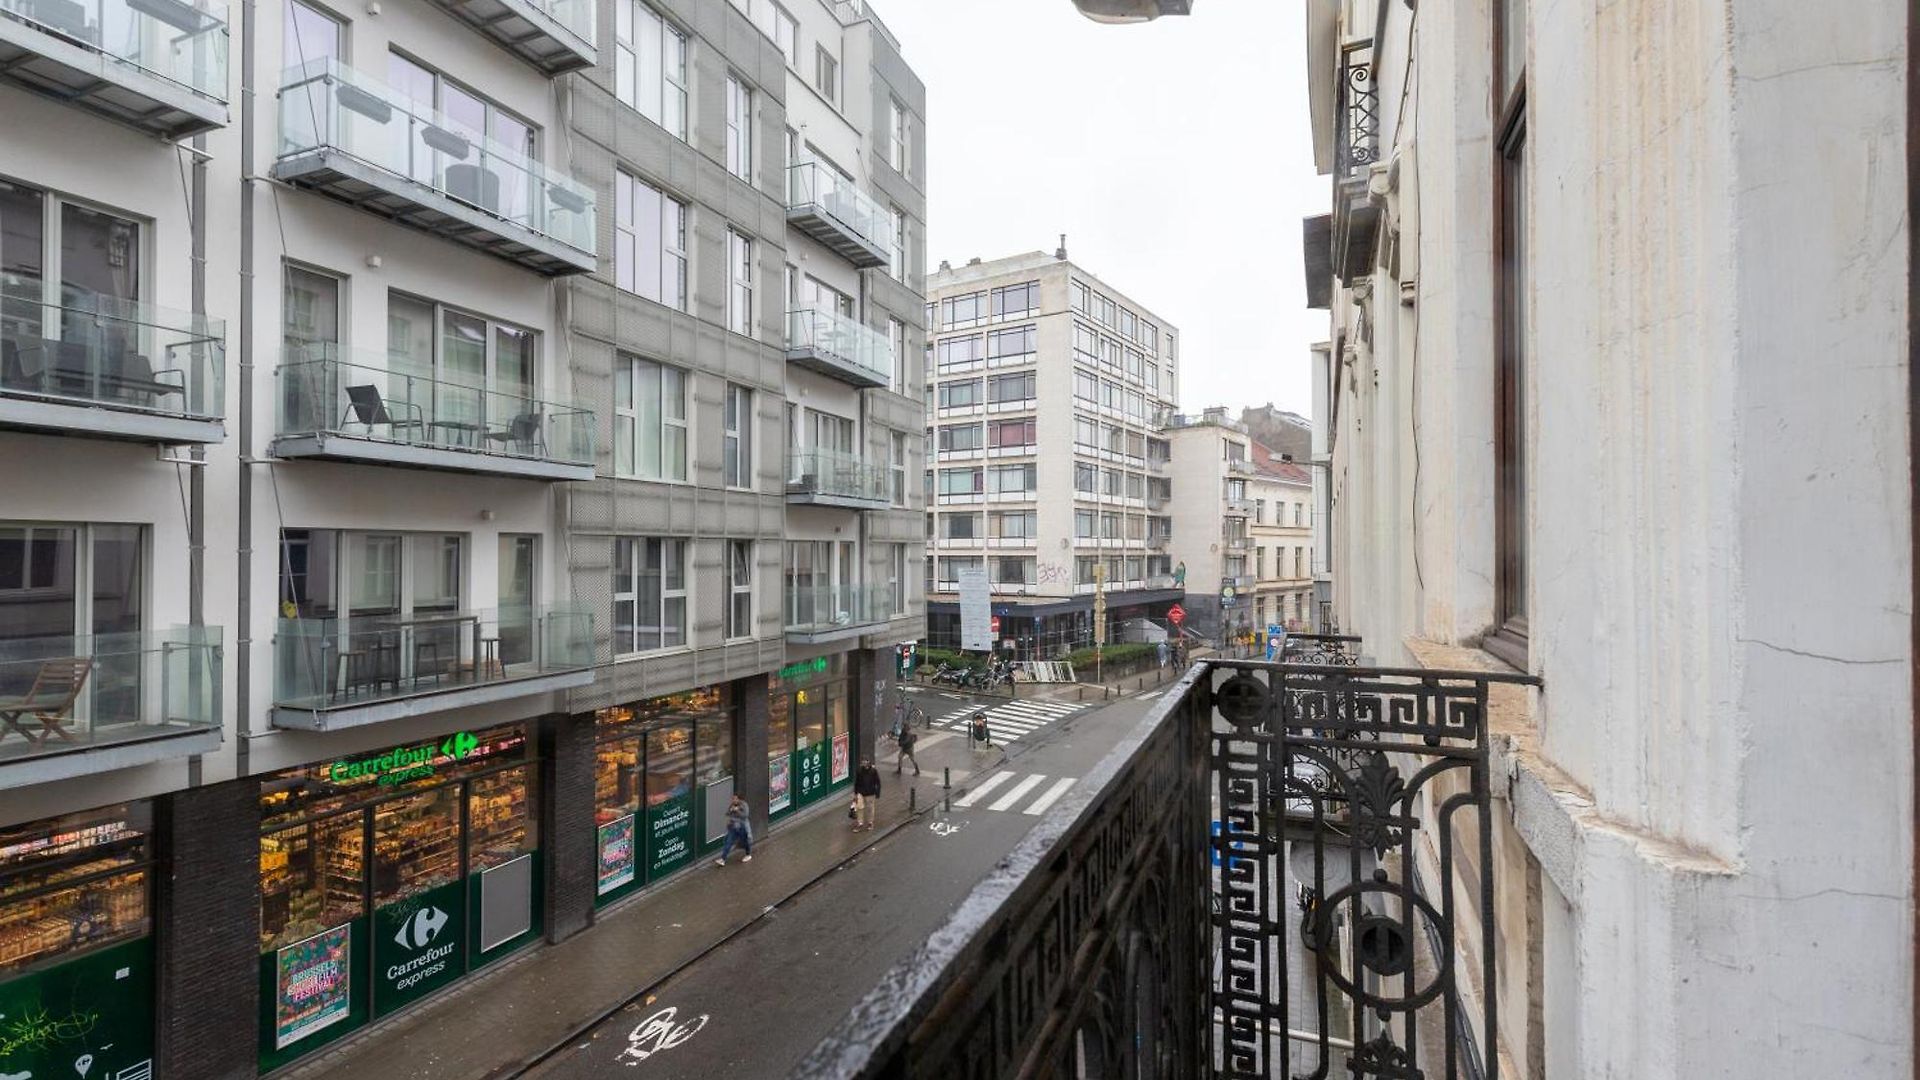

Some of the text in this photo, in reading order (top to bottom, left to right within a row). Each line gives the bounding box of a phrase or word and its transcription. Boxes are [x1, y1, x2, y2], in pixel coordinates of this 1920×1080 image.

[330, 744, 435, 782] Carrefour
[377, 765, 435, 787] express
[654, 810, 689, 830] Dimanche
[658, 841, 684, 858] Zondag
[291, 960, 337, 985] BRUSSELS
[387, 941, 455, 980] Carrefour
[397, 961, 445, 990] express
[293, 976, 334, 1002] FESTIVAL
